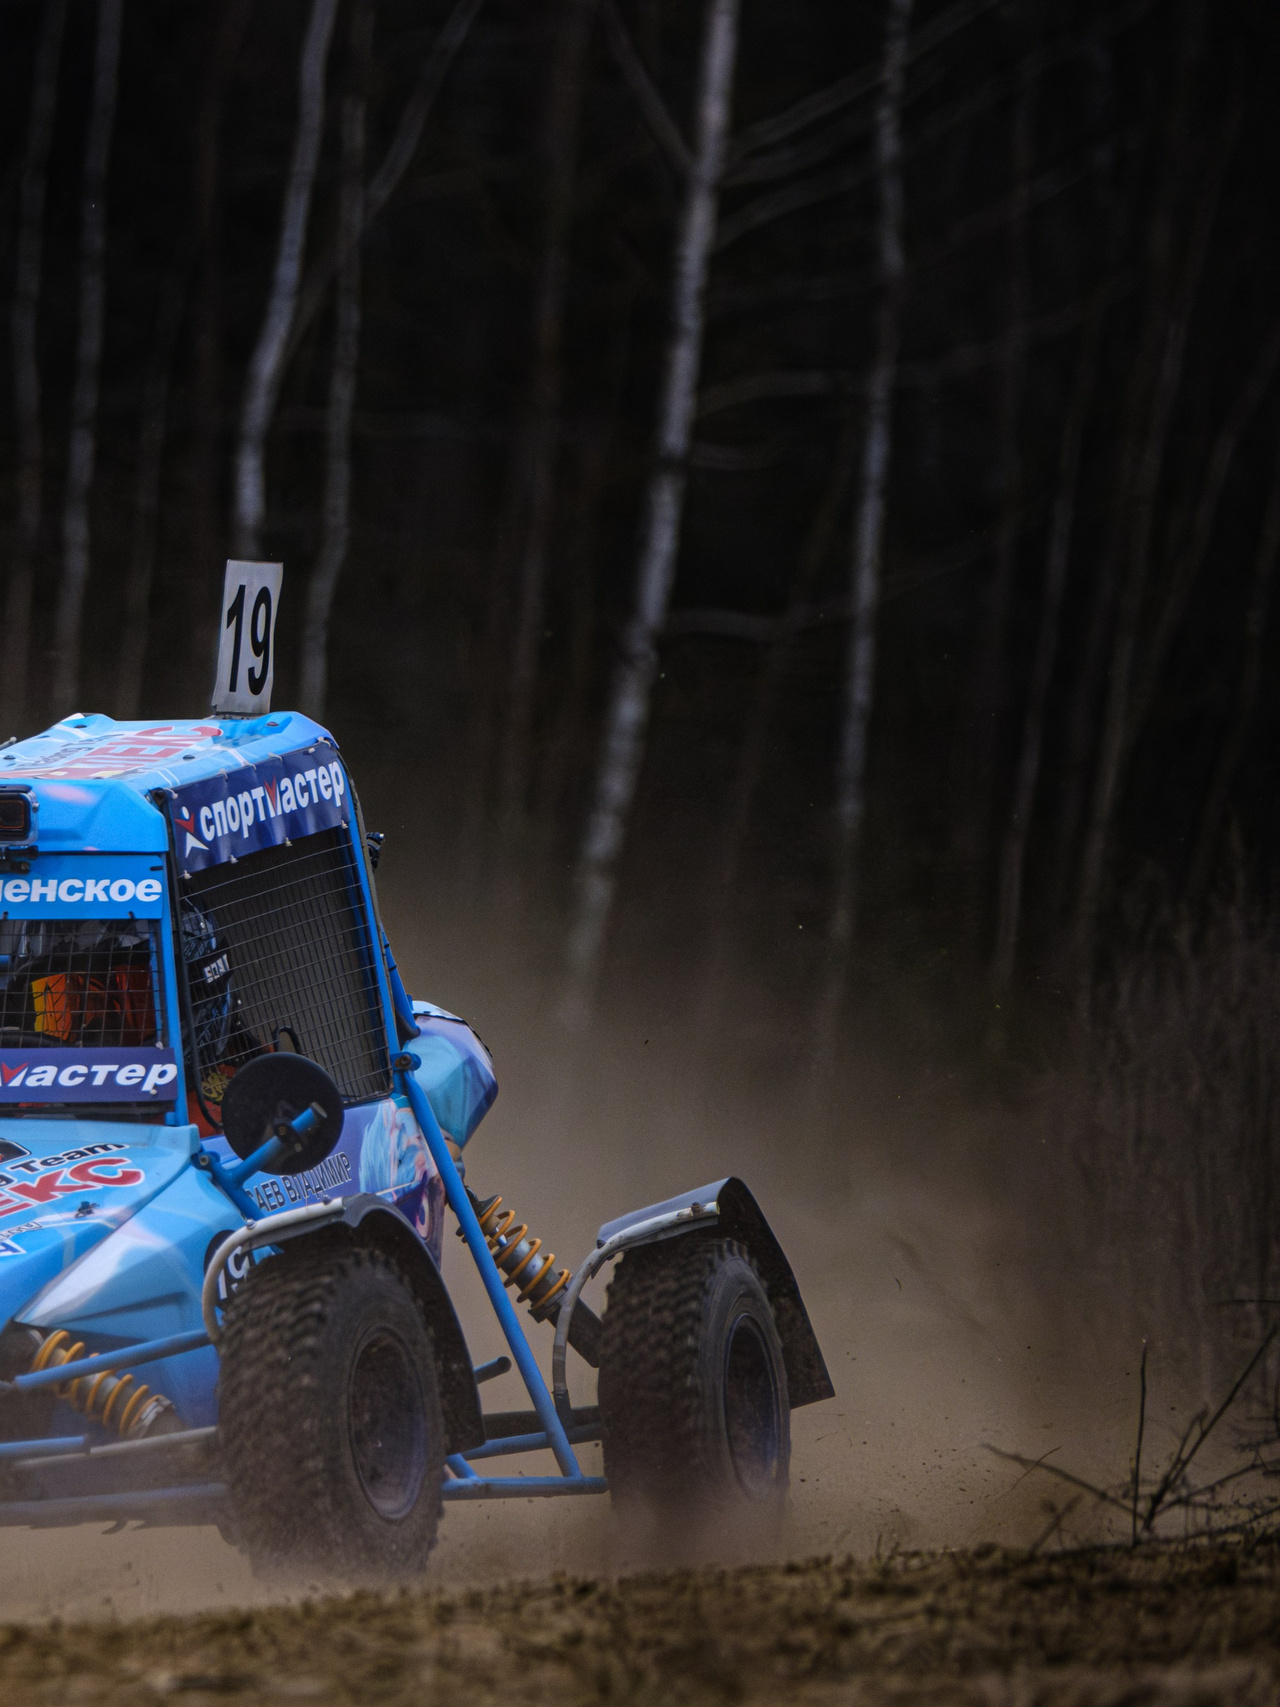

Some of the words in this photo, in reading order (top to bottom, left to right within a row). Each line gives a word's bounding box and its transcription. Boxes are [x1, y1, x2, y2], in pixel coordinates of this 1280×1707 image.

[227, 584, 272, 695] 19
[7, 1144, 129, 1174] Team
[281, 1151, 352, 1204] ВЛАДИМИР
